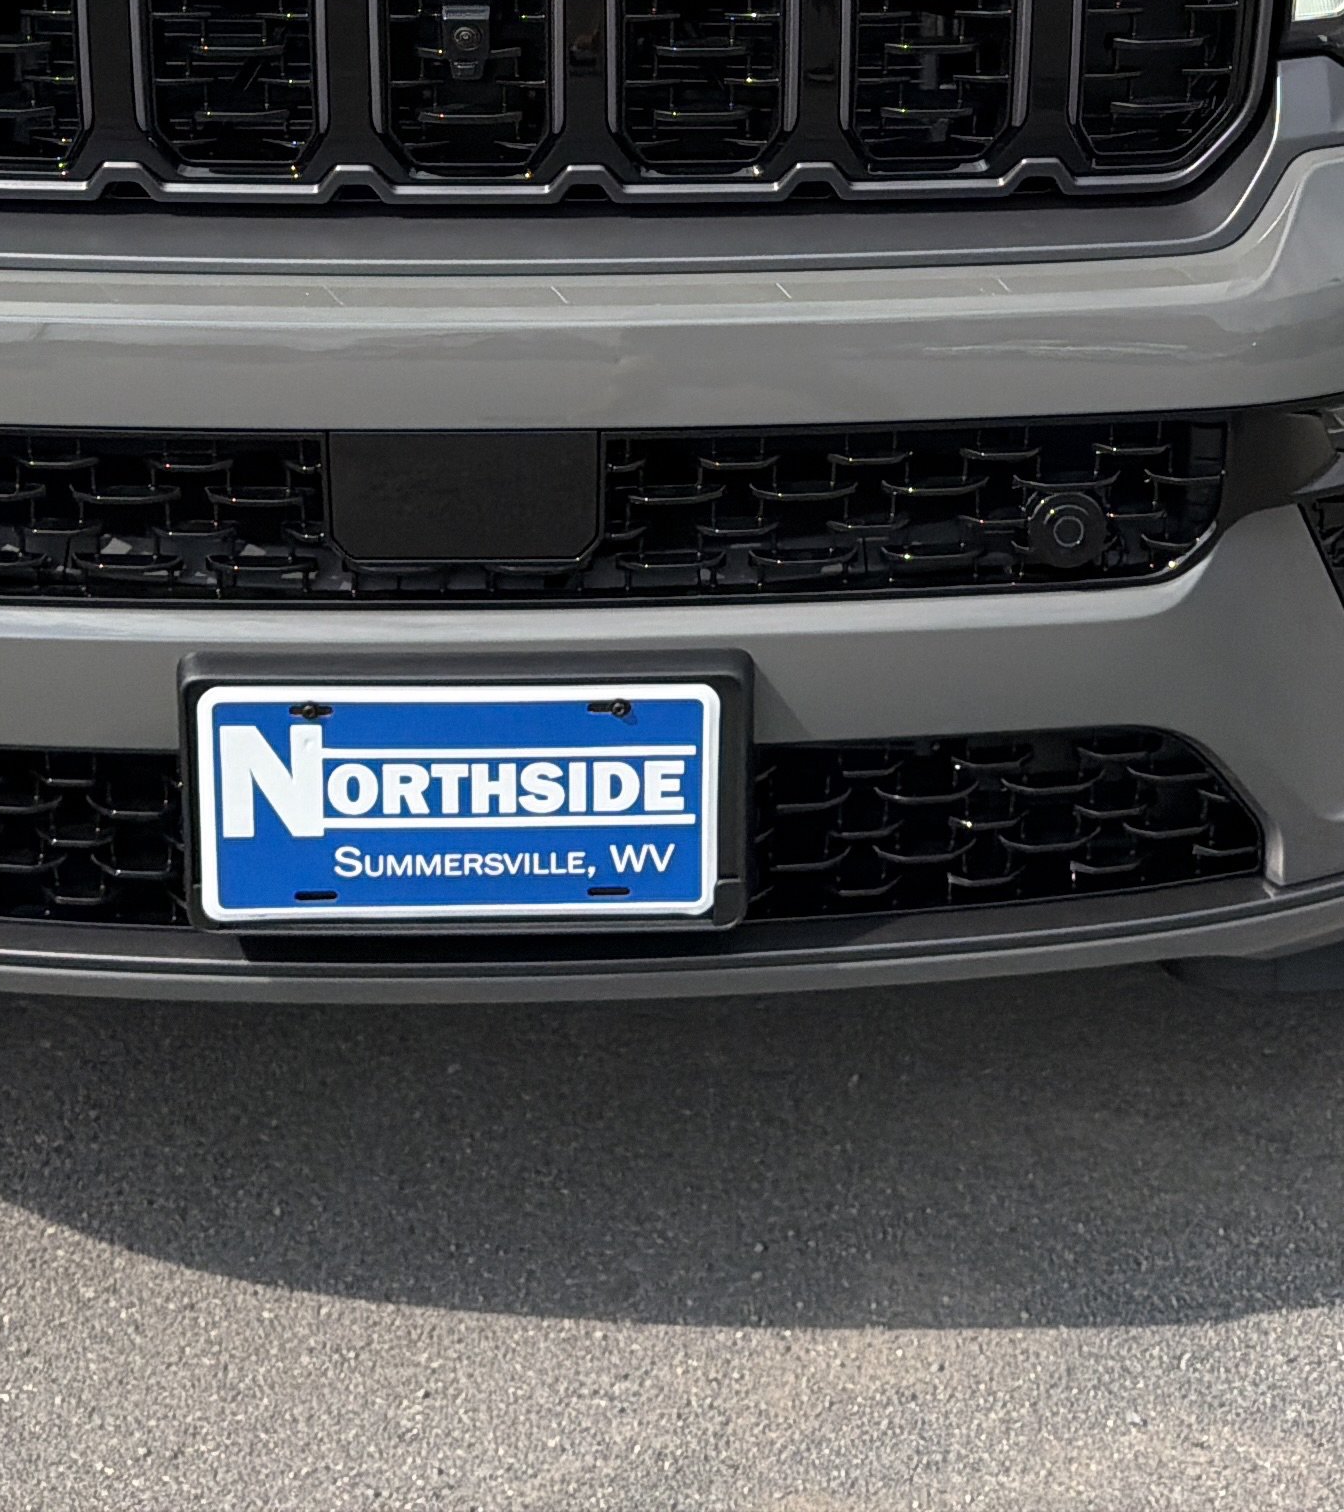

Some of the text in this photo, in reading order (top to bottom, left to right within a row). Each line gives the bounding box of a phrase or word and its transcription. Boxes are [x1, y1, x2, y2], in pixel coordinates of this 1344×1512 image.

[219, 724, 686, 838] NORTHSIDE
[333, 842, 676, 879] SUMMERSVILLE, WV
